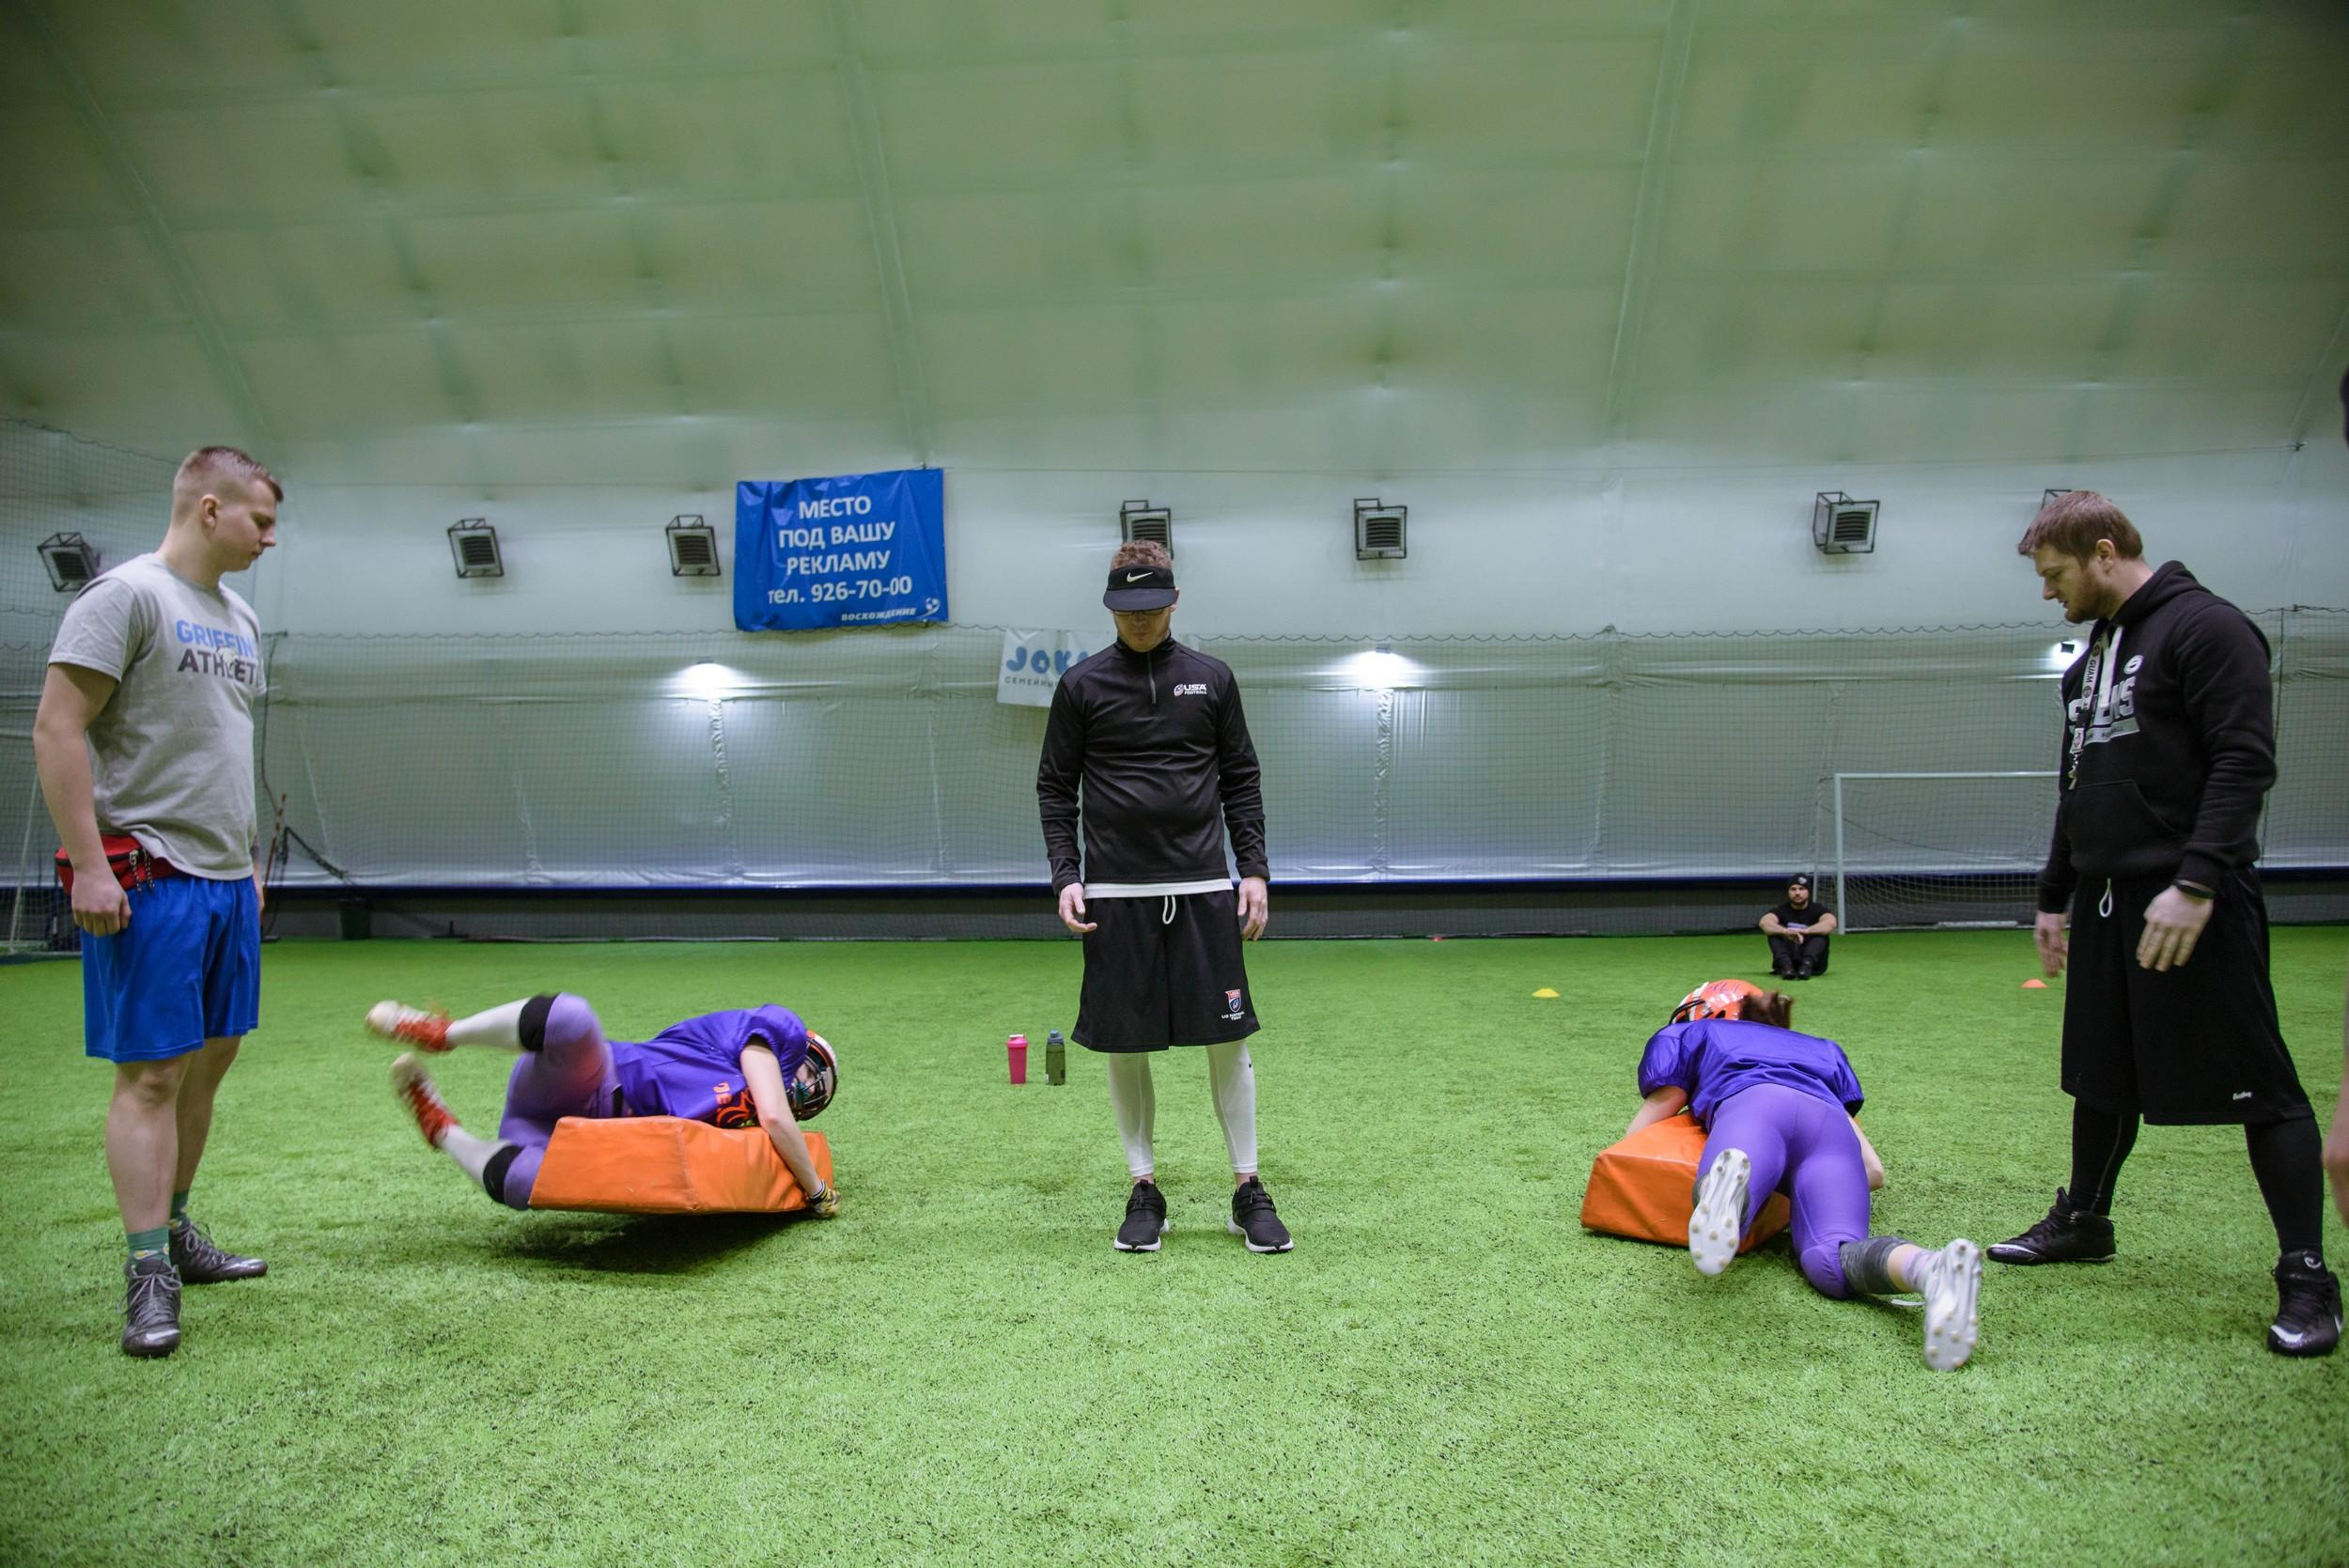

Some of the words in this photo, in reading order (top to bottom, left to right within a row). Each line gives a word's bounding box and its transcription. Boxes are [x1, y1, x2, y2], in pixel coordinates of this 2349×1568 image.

[799, 495, 872, 520] МЕСТО
[778, 529, 826, 550] ПОД
[830, 521, 895, 545] ВАШУ
[786, 550, 891, 576] РЕКЛАМУ
[768, 588, 805, 605] тел.
[811, 575, 912, 603] 926-70-00
[2085, 660, 2096, 683] GUAM
[1183, 683, 1207, 691] USA
